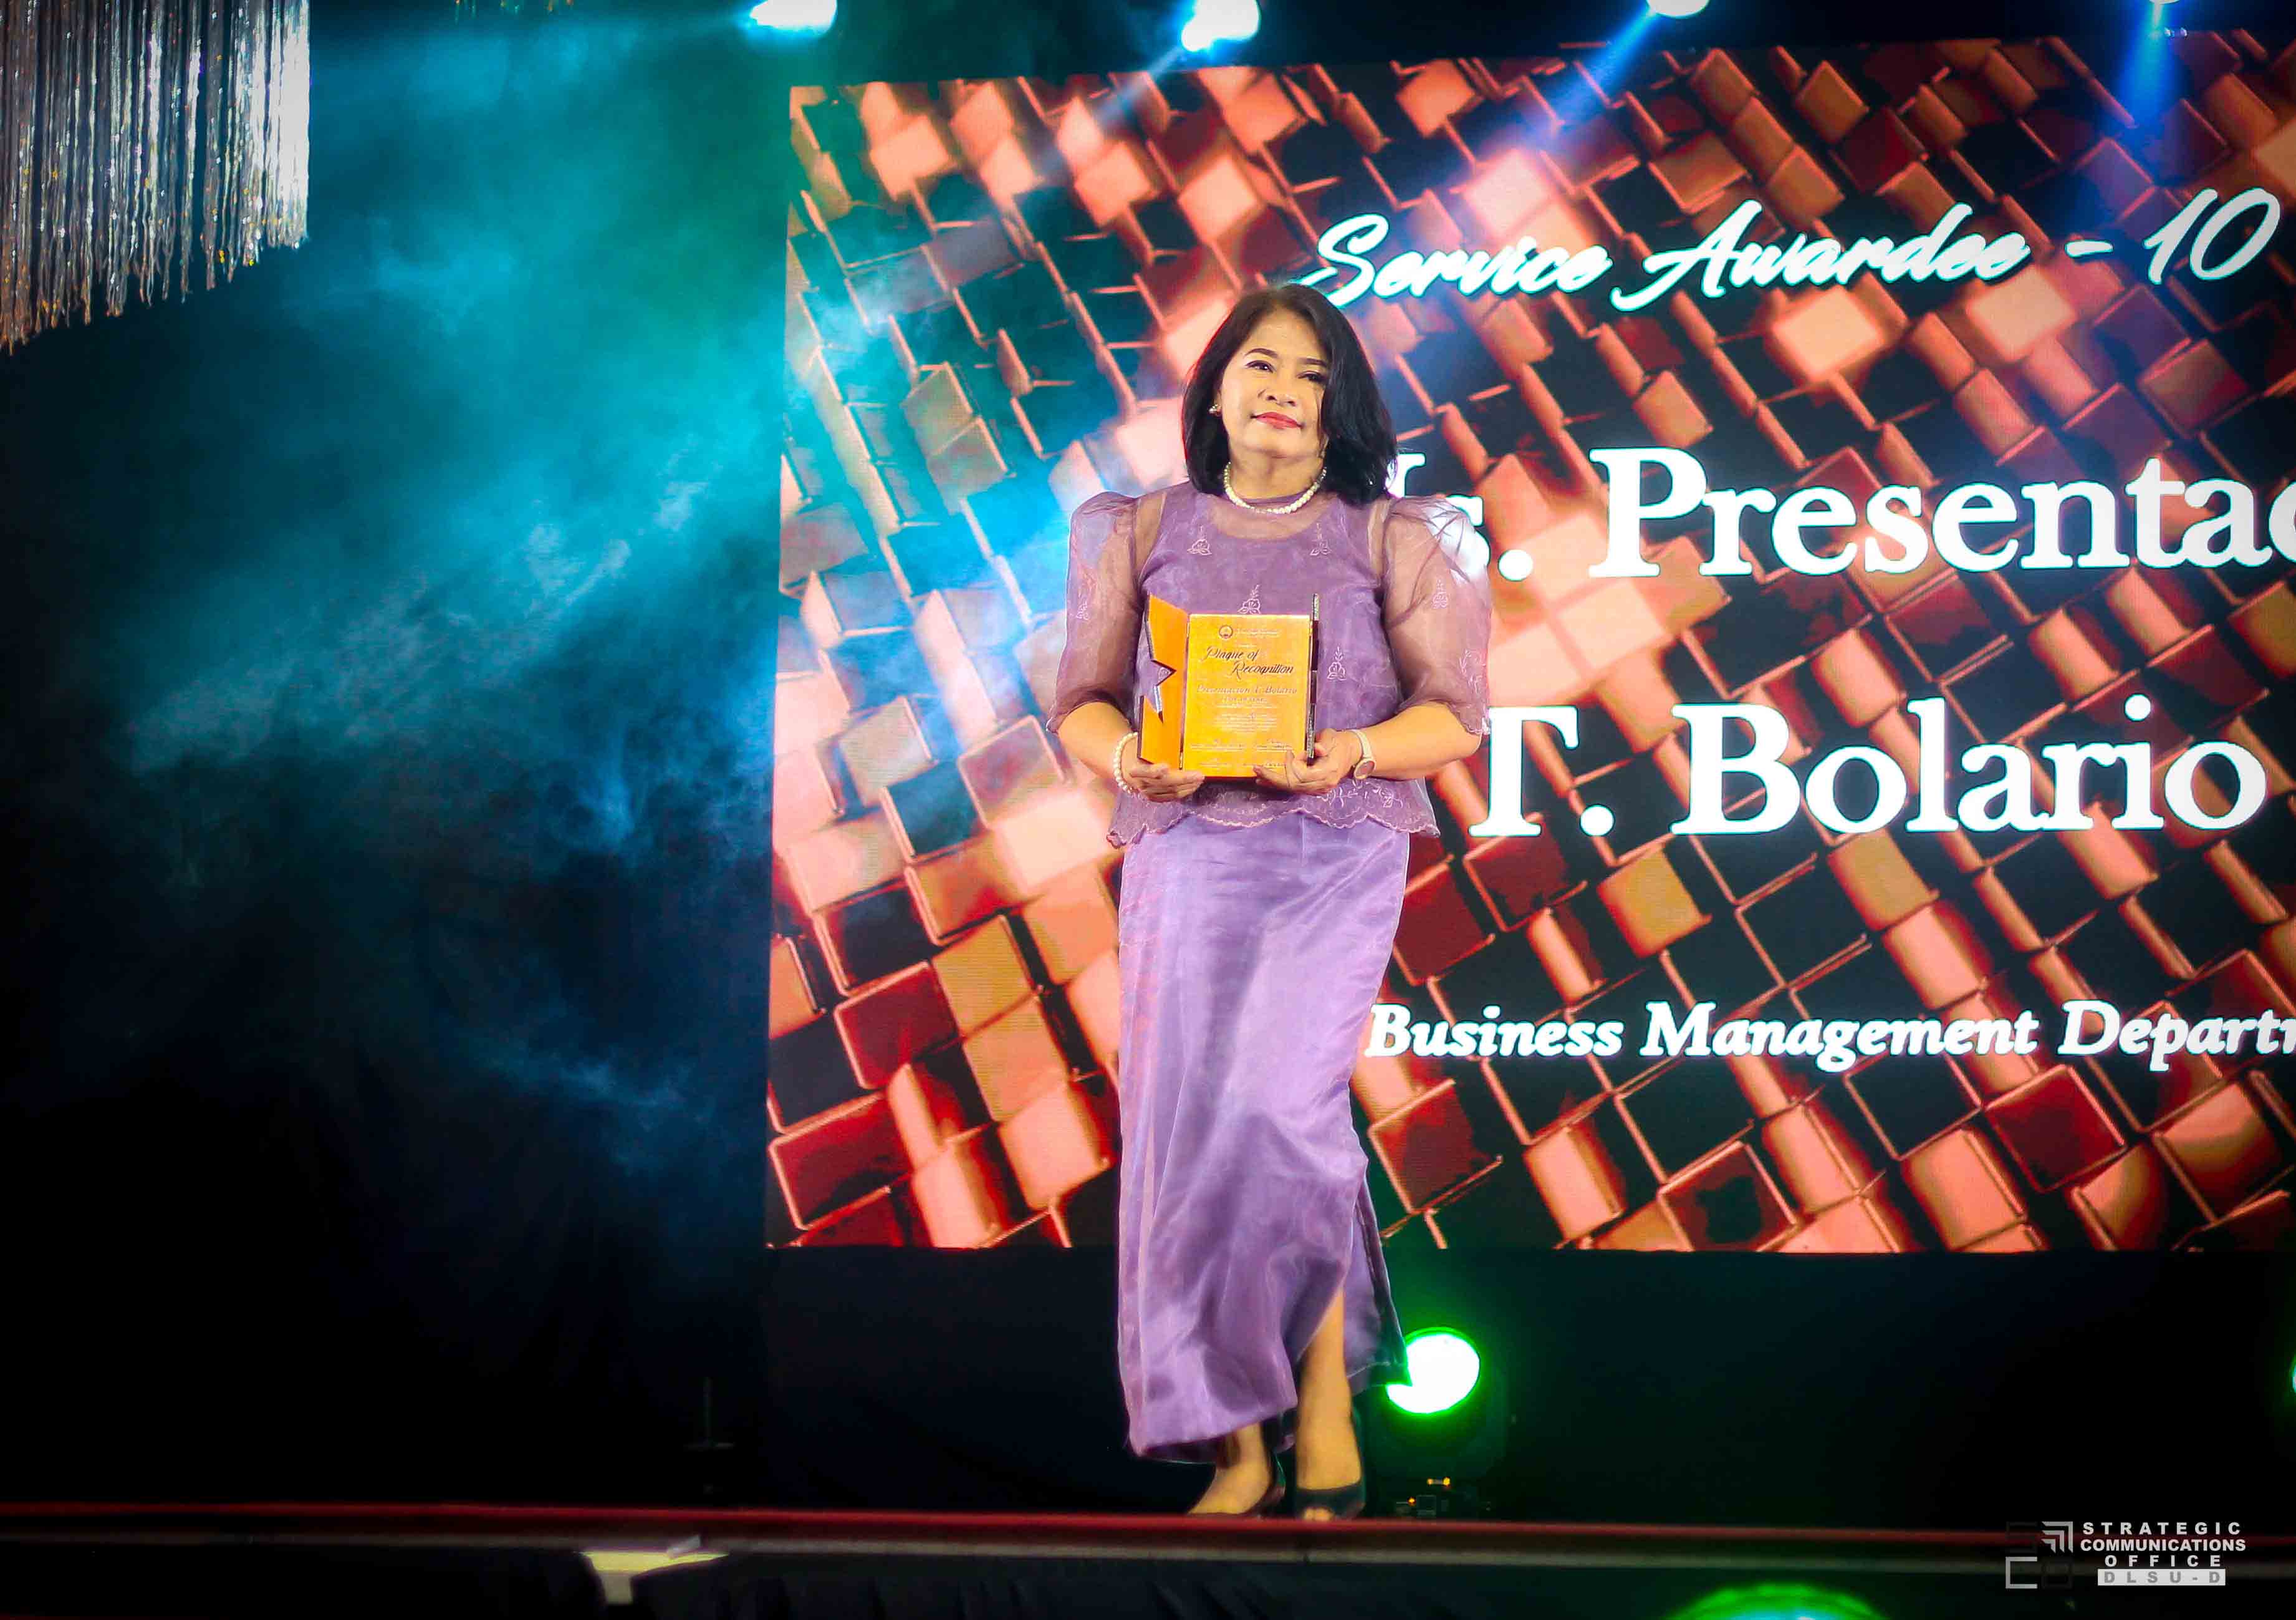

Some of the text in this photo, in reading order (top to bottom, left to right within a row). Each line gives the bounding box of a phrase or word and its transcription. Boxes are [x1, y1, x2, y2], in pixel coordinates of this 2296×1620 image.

[1292, 213, 1613, 308] Service
[1610, 198, 2033, 312] Awardee
[2144, 188, 2281, 285] 10
[1247, 648, 1259, 662] of
[1468, 693, 2267, 837] T. Bolario
[1364, 1002, 1623, 1058] Business
[1639, 1000, 2040, 1073] Management
